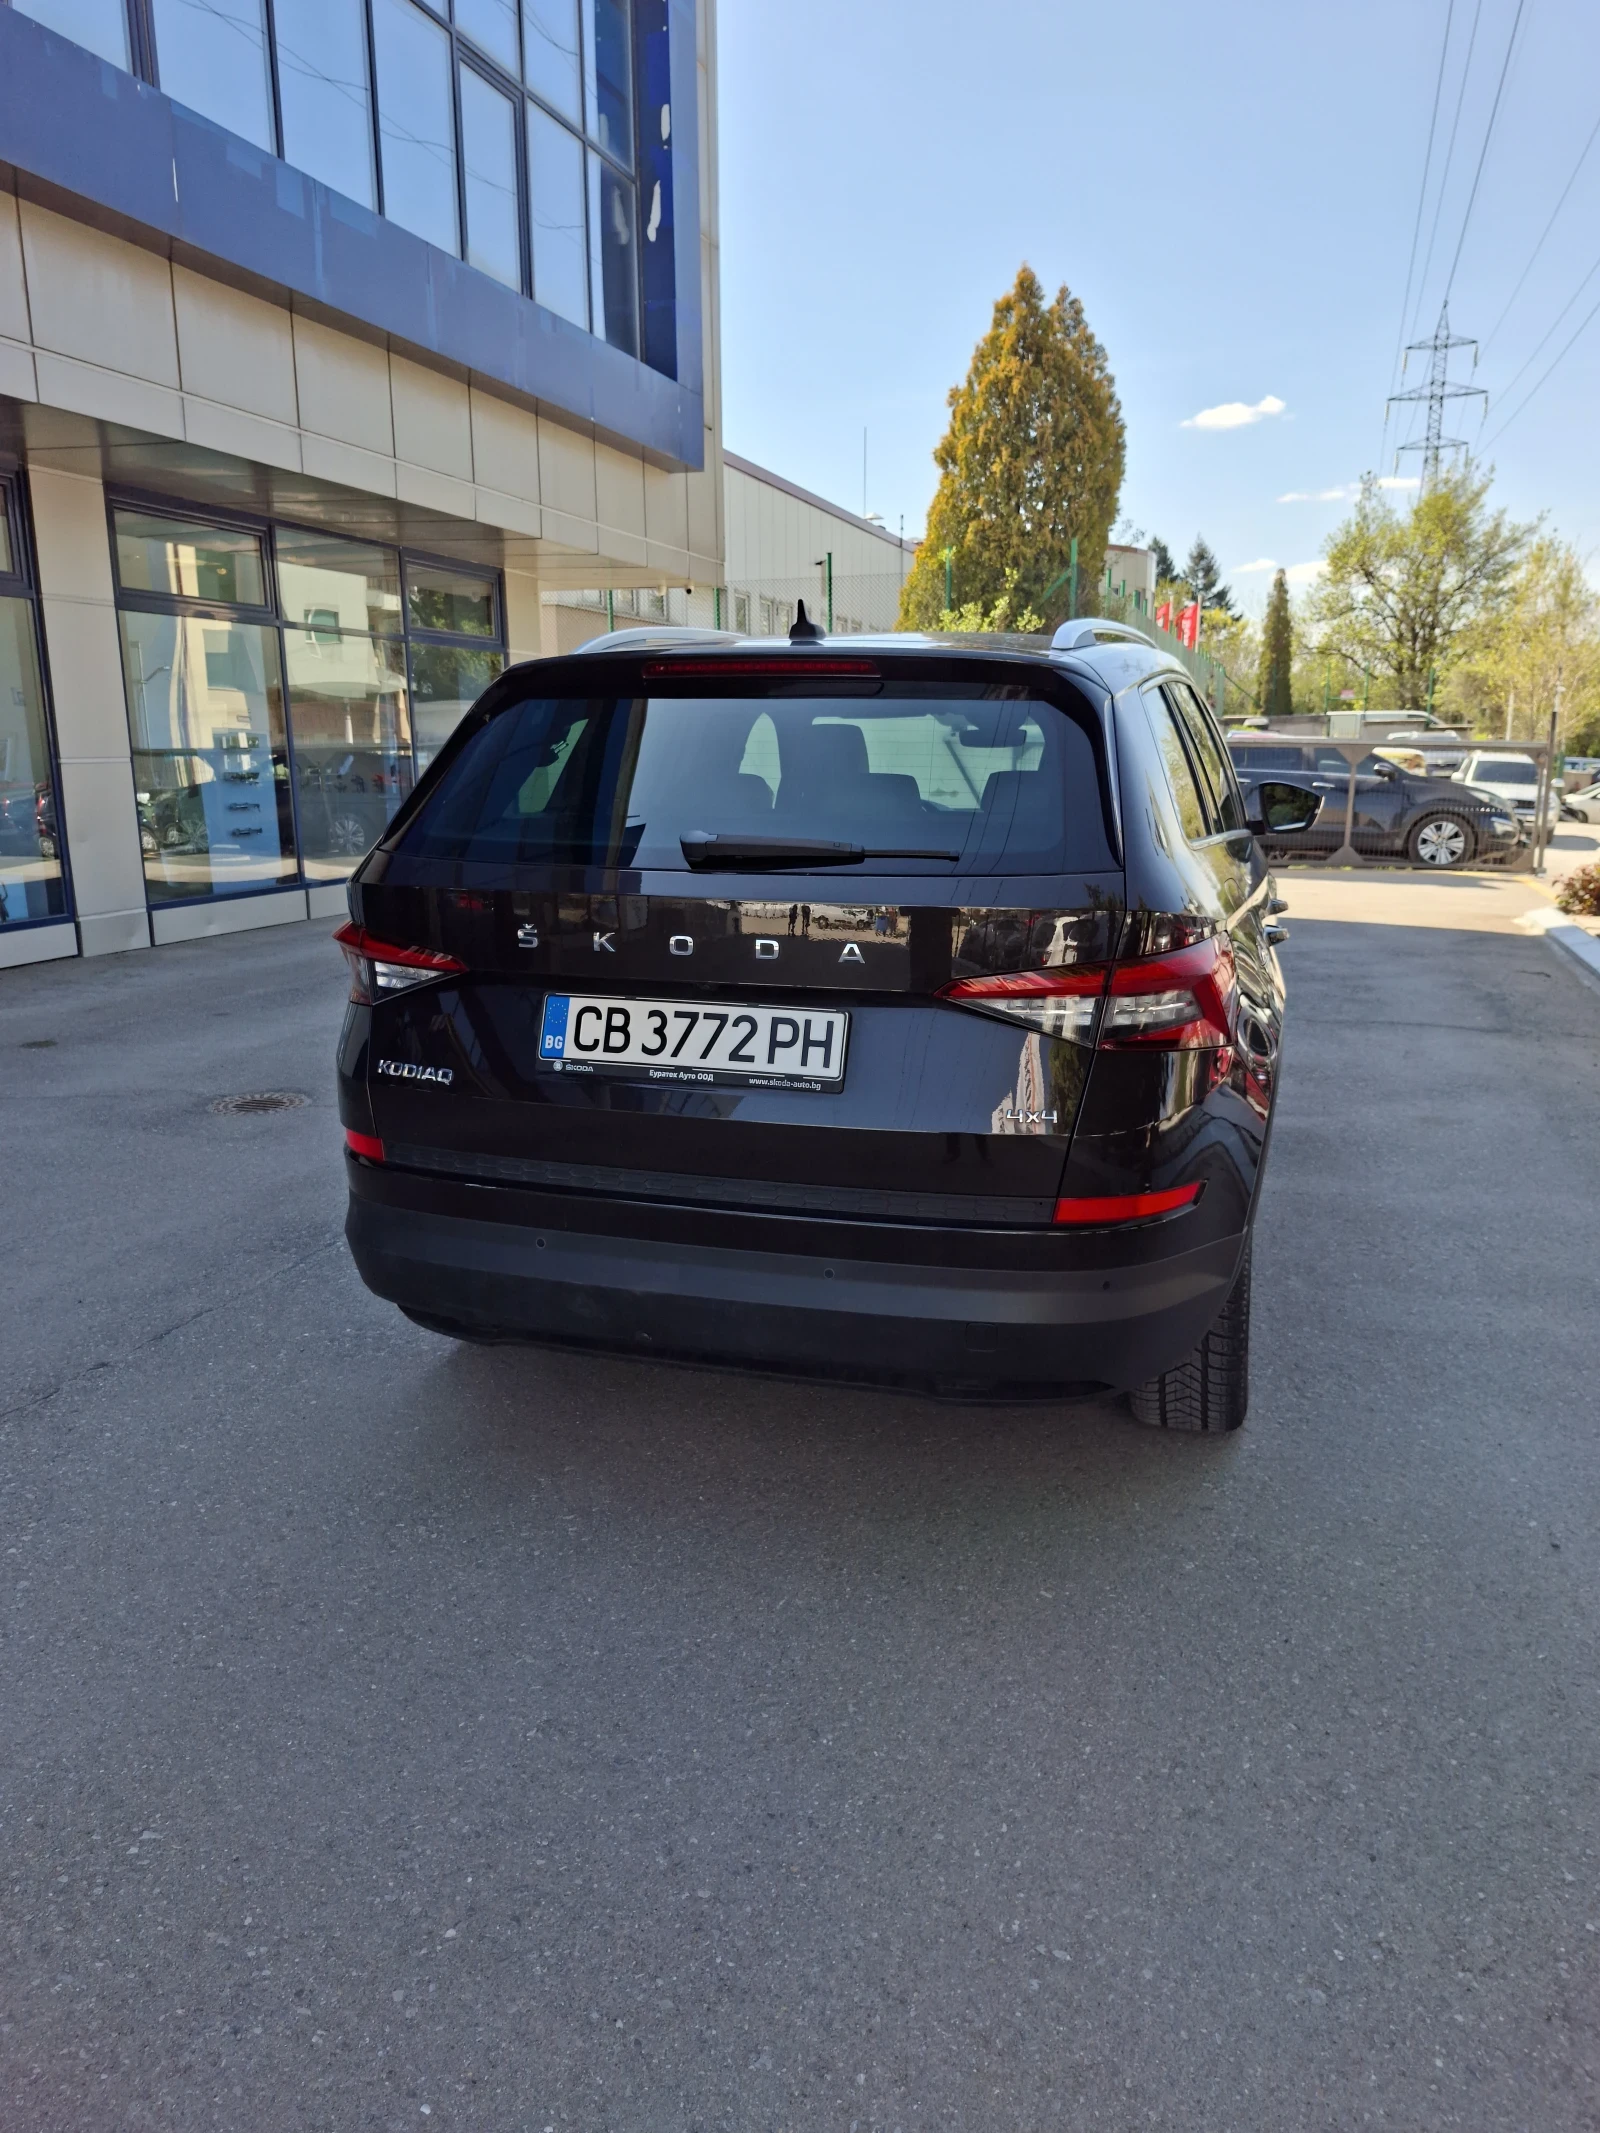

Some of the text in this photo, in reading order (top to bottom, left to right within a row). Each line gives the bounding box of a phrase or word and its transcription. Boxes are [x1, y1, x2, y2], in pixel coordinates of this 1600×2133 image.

[517, 923, 866, 964] ŠKODA
[545, 1034, 563, 1050] BG
[573, 1006, 834, 1069] CB 3772 PH
[377, 1059, 453, 1086] KODIAQ
[565, 1063, 594, 1073] ŠKODA
[679, 1072, 696, 1081] Ауто
[697, 1073, 714, 1082] ООД
[749, 1077, 822, 1091] www.skoda-auto.bg
